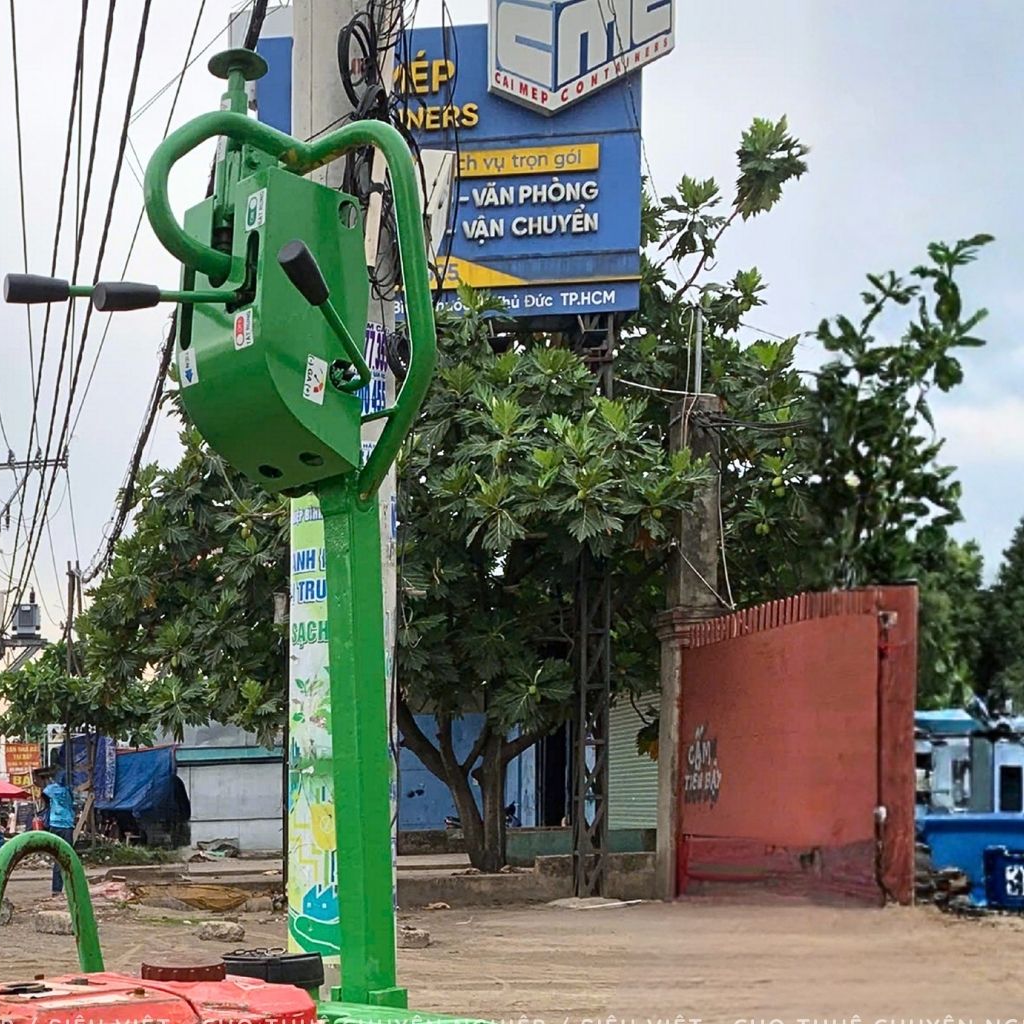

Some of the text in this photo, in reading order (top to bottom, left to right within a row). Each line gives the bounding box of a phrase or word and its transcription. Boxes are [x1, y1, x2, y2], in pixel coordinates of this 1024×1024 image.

[519, 83, 549, 105] MEP
[512, 154, 548, 170] trọn
[554, 149, 581, 169] gói
[519, 177, 599, 204] PHÒNG
[462, 203, 598, 244] VẬN CHUYỂN
[524, 294, 553, 308] Đức
[561, 290, 616, 306] TP.HCM
